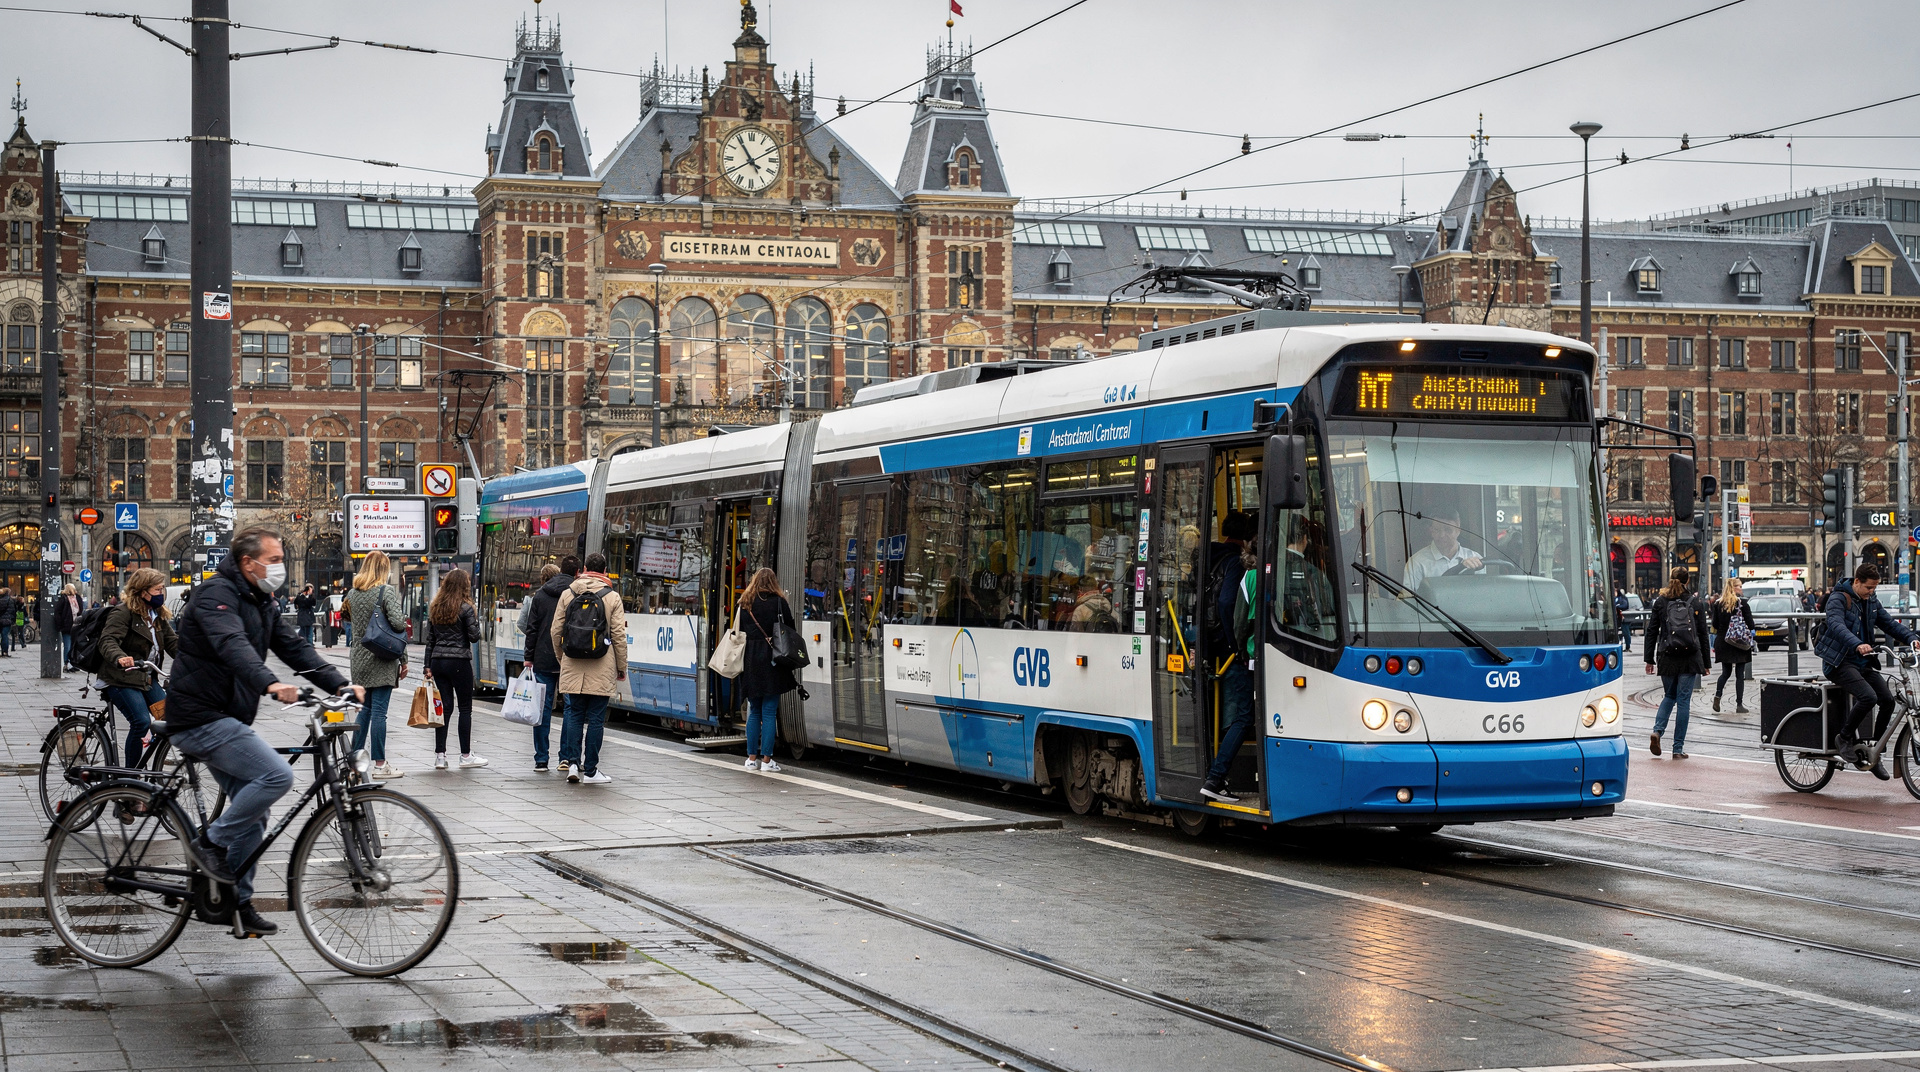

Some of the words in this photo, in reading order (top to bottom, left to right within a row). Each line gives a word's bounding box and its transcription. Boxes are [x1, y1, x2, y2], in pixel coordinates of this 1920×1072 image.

[757, 244, 831, 259] CENTAOAL
[656, 626, 674, 652] GVB
[1013, 646, 1051, 688] GVB
[1485, 670, 1521, 688] GVB
[1482, 714, 1525, 734] C66
